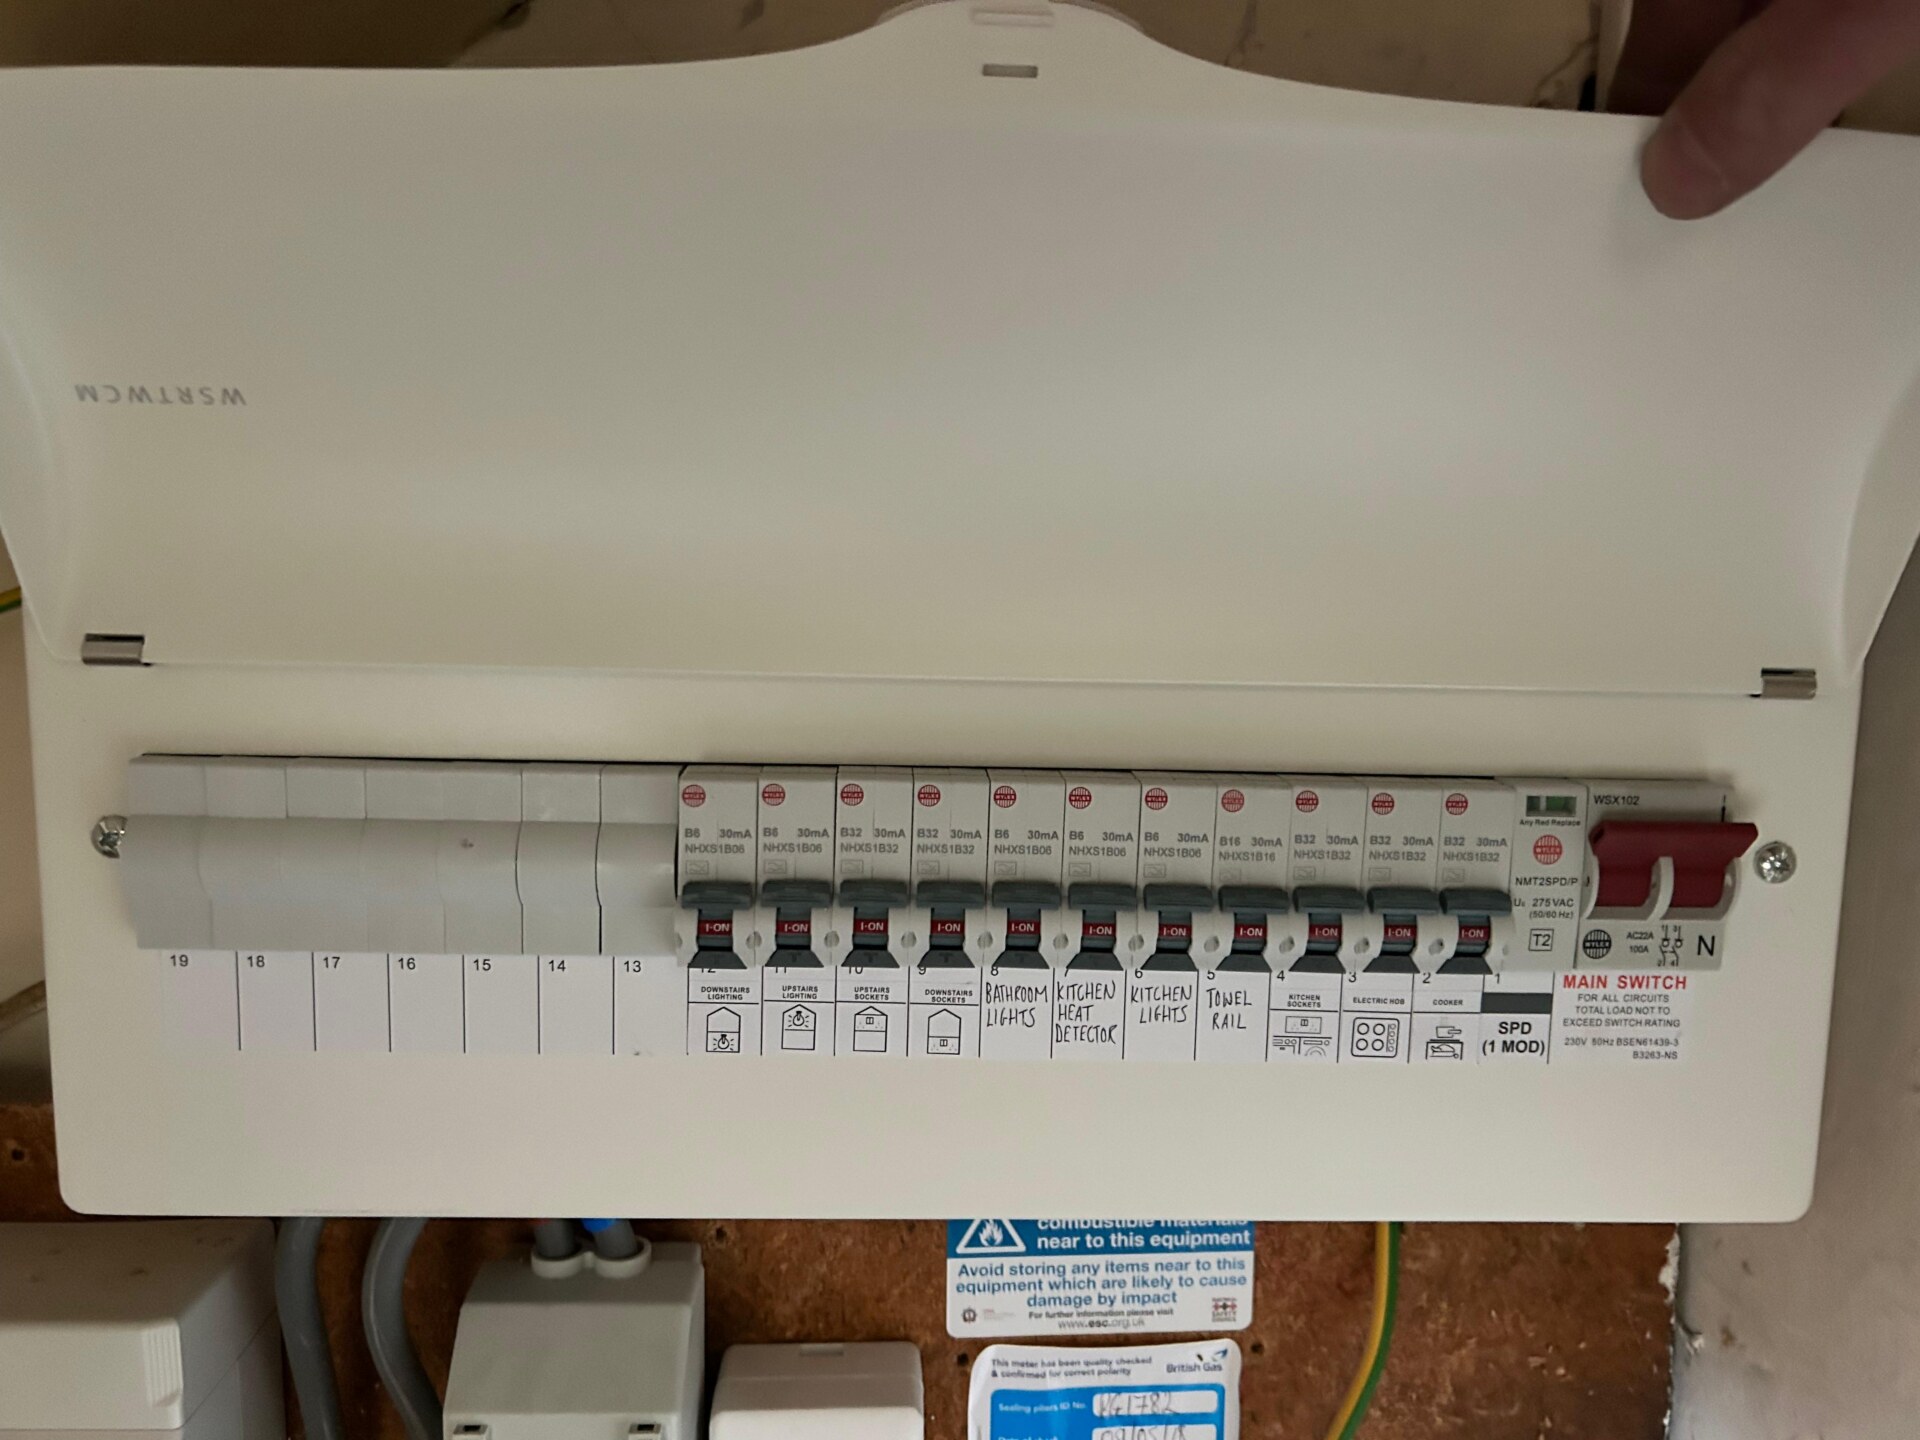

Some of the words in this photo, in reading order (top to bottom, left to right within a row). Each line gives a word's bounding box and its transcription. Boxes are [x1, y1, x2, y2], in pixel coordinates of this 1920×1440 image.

[75, 384, 247, 406] WSRTWCM
[1594, 795, 1640, 805] WSX102
[685, 828, 700, 838] B6
[719, 829, 752, 839] 30mA
[763, 828, 778, 837] B6
[797, 829, 829, 838] 30mA
[840, 828, 862, 838] B32
[874, 829, 906, 838] 30mA
[917, 828, 938, 838] B32
[950, 829, 982, 839] 30mA
[994, 830, 1009, 839] B6
[1027, 830, 1059, 840] 30mA
[1069, 831, 1084, 840] B6
[1102, 832, 1134, 842] 30mA
[1144, 832, 1159, 841] B6
[1177, 833, 1209, 843] 30mA
[1220, 836, 1241, 846] B16
[1251, 837, 1282, 847] 30mA
[1294, 834, 1316, 844] B32
[1326, 835, 1359, 845] 30mA
[1370, 836, 1391, 845] B32
[1402, 836, 1434, 846] 30mA
[1444, 836, 1465, 846] B32
[1476, 837, 1507, 847] 30mA
[685, 844, 745, 854] NHXS1B06
[763, 843, 822, 853] NHXS1B06
[840, 843, 898, 853] NHXS1B32
[916, 844, 975, 854] NHXS1B32
[994, 845, 1052, 854] NHXS1B06
[1068, 846, 1126, 857] NHXS1B06
[1144, 847, 1201, 858] NHXS1B06
[1219, 851, 1276, 862] NHXS1B16
[1294, 850, 1351, 860] NHXS1B32
[1369, 851, 1426, 861] NHXS1B32
[1443, 852, 1500, 862] NHXS1B32
[1515, 877, 1578, 886] NMT2SPD/P
[1532, 898, 1551, 907] 275
[1552, 898, 1574, 907] VAC
[1533, 934, 1551, 947] T2
[1697, 935, 1715, 956] N
[170, 955, 189, 968] 19
[247, 956, 265, 968] 18
[323, 956, 341, 969] 17
[398, 958, 416, 970] 16
[473, 959, 491, 972] 15
[548, 959, 566, 972] 14
[623, 961, 641, 973] 13
[990, 966, 999, 976] 8
[1134, 970, 1143, 979] 6
[1206, 970, 1216, 980] 5
[1276, 970, 1286, 982] 4
[1348, 971, 1357, 983] 3
[1422, 972, 1432, 984] 2
[1563, 975, 1608, 989] MAIN
[1617, 975, 1687, 990] SWITCH
[701, 986, 750, 994] DOWNSTAIRS
[782, 985, 819, 993] UPSTAIRS
[854, 986, 890, 994] UPSTAIRS
[925, 989, 973, 997] DOWNSTAIRS
[986, 982, 1047, 1004] BATHROOM
[1057, 980, 1116, 1002] KITCHEN
[1130, 984, 1192, 1003] KITCHEN
[707, 993, 743, 1001] LIGHTING
[782, 992, 817, 1000] LIGHTING
[854, 993, 889, 1001] SOCKETS
[931, 996, 966, 1004] SOCKETS
[1206, 988, 1252, 1009] TOWEL
[1352, 997, 1388, 1005] ELECTRIC
[1578, 993, 1598, 1002] FOR
[1601, 994, 1619, 1003] ALL
[1623, 994, 1670, 1003] CIRCUITS
[1287, 1000, 1321, 1008] SOCKETS
[1058, 1004, 1094, 1022] HEAT
[1139, 1005, 1188, 1024] LIGHTS
[1575, 1006, 1605, 1015] TOTAL
[1607, 1006, 1633, 1015] LOAD
[1635, 1006, 1655, 1015] NOT
[1657, 1006, 1671, 1015] TO
[987, 1007, 1036, 1027] LIGHTS
[1212, 1012, 1247, 1030] RAIL
[1498, 1021, 1532, 1035] SPD
[1562, 1018, 1602, 1027] EXCEED
[1604, 1018, 1642, 1027] SWITCH
[1644, 1019, 1680, 1028] RATING
[1056, 1023, 1118, 1044] DETECTOR
[1564, 1037, 1588, 1046] 230V
[1482, 1040, 1496, 1056] (1
[1501, 1040, 1545, 1056] MOD)
[1037, 1236, 1081, 1249] near
[1085, 1234, 1105, 1248] to
[1109, 1232, 1145, 1248] this
[1150, 1230, 1251, 1249] equipment
[958, 1263, 1004, 1277] Avoid
[1009, 1262, 1066, 1277] storing
[1071, 1263, 1100, 1276] any
[1105, 1260, 1149, 1273] items
[1154, 1261, 1191, 1272] near
[1195, 1259, 1211, 1271] to
[1217, 1257, 1246, 1270] this
[956, 1279, 1043, 1295] equipment
[1048, 1277, 1096, 1291] which
[1101, 1279, 1127, 1289] are
[1132, 1275, 1173, 1290] likely
[1178, 1275, 1194, 1288] to
[1199, 1275, 1247, 1287] cause
[1027, 1293, 1093, 1308] damage
[1097, 1292, 1116, 1307] by
[1121, 1291, 1177, 1306] impact
[1029, 1311, 1043, 1320] For
[1045, 1310, 1074, 1319] further
[1076, 1309, 1125, 1318] information
[1126, 1308, 1155, 1317] please
[1156, 1308, 1174, 1316] visit
[991, 1359, 1009, 1367] This
[1011, 1360, 1038, 1368] meter
[1041, 1359, 1056, 1367] has
[1058, 1358, 1081, 1367] been
[1166, 1363, 1201, 1373] British
[1202, 1362, 1223, 1372] Gas
[1001, 1370, 1046, 1379] confirmed
